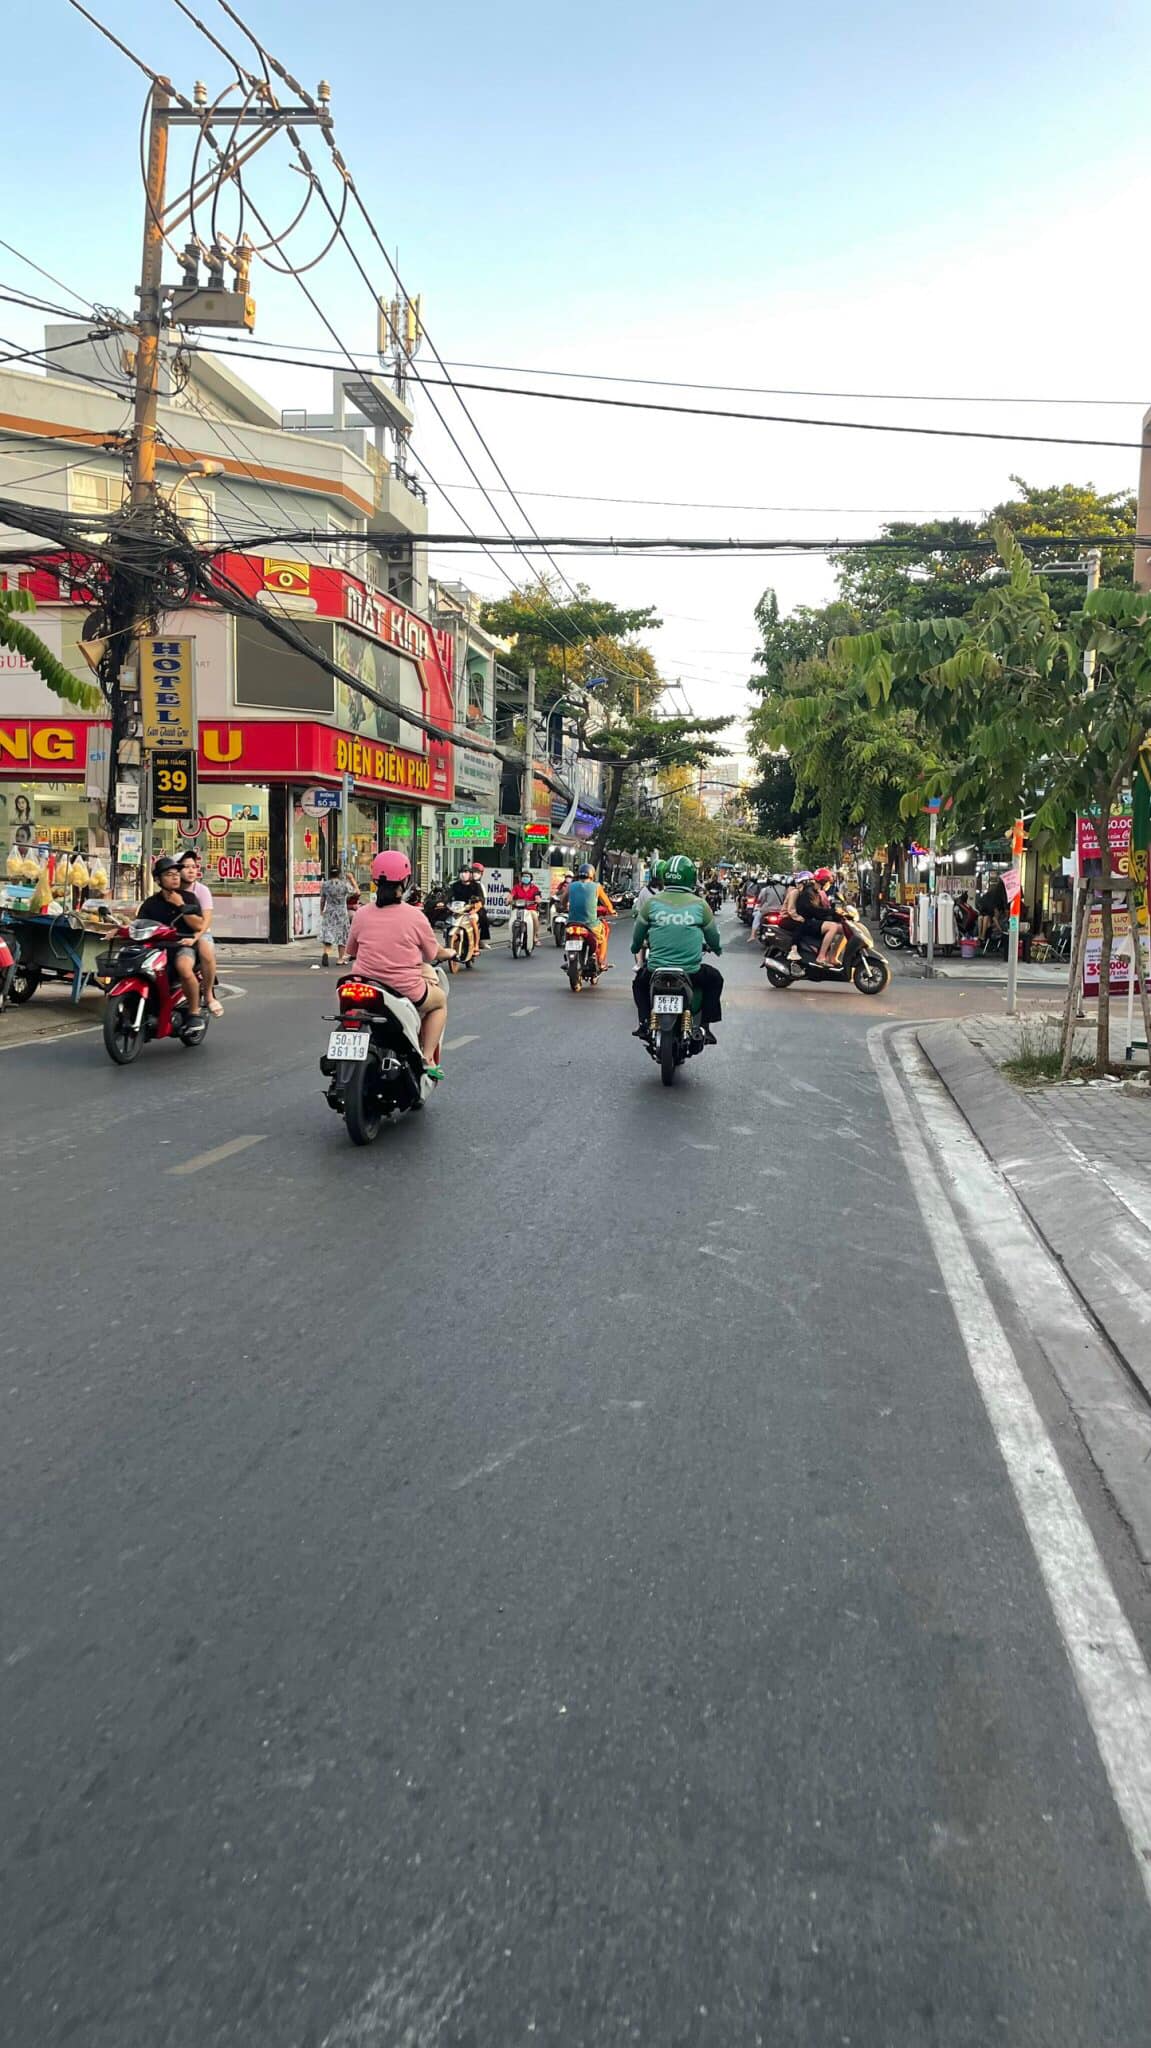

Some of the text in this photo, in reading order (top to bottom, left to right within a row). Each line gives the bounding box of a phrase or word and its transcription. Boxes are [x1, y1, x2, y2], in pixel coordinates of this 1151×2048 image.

[346, 583, 386, 635] MẮT
[391, 609, 429, 660] KÍNH
[151, 642, 181, 725] HOTEL
[337, 735, 371, 780] ĐIỆN
[375, 744, 405, 785] BIÊN
[408, 757, 430, 790] PHỦ
[158, 770, 187, 792] 39
[217, 851, 244, 879] GIÁ
[249, 850, 265, 879] SỈ
[664, 872, 682, 880] Grab
[655, 910, 696, 927] Grab
